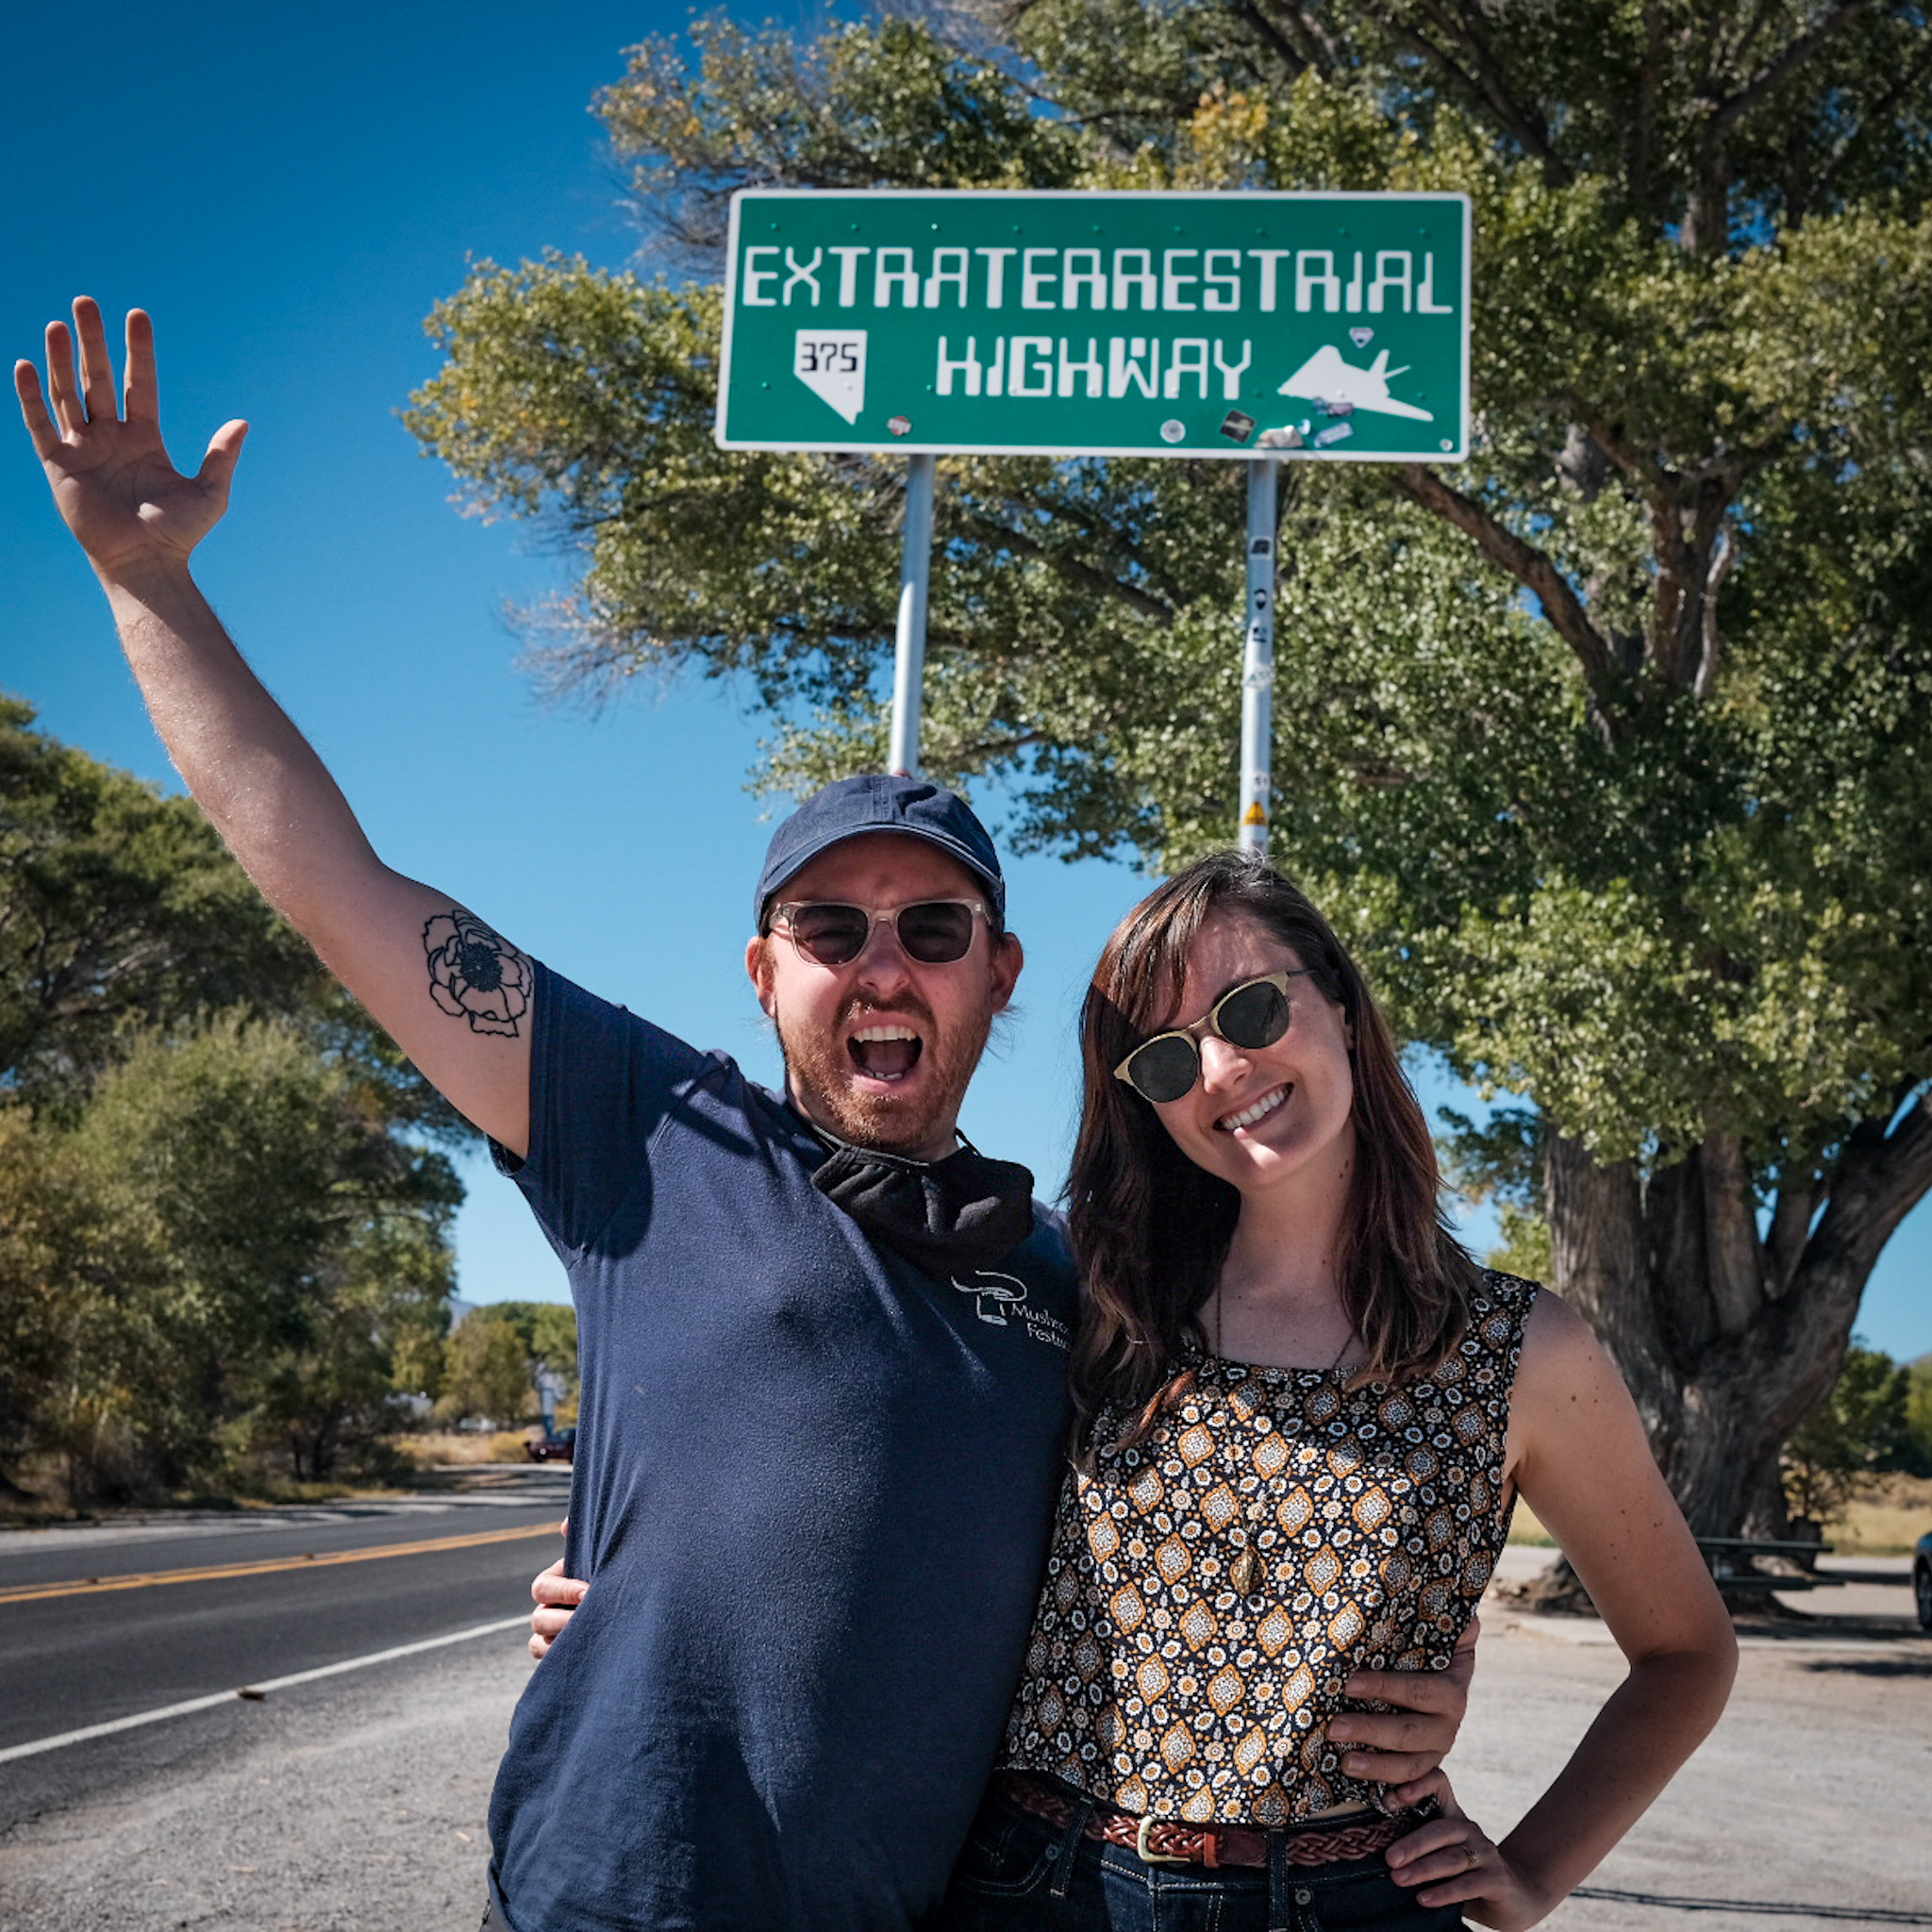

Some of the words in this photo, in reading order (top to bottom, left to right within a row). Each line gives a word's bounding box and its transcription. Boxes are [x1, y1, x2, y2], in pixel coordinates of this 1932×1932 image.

[742, 245, 1454, 314] EXTRATERRESTRIAL
[801, 341, 858, 372] 375
[936, 336, 1252, 401] HIGHWAY
